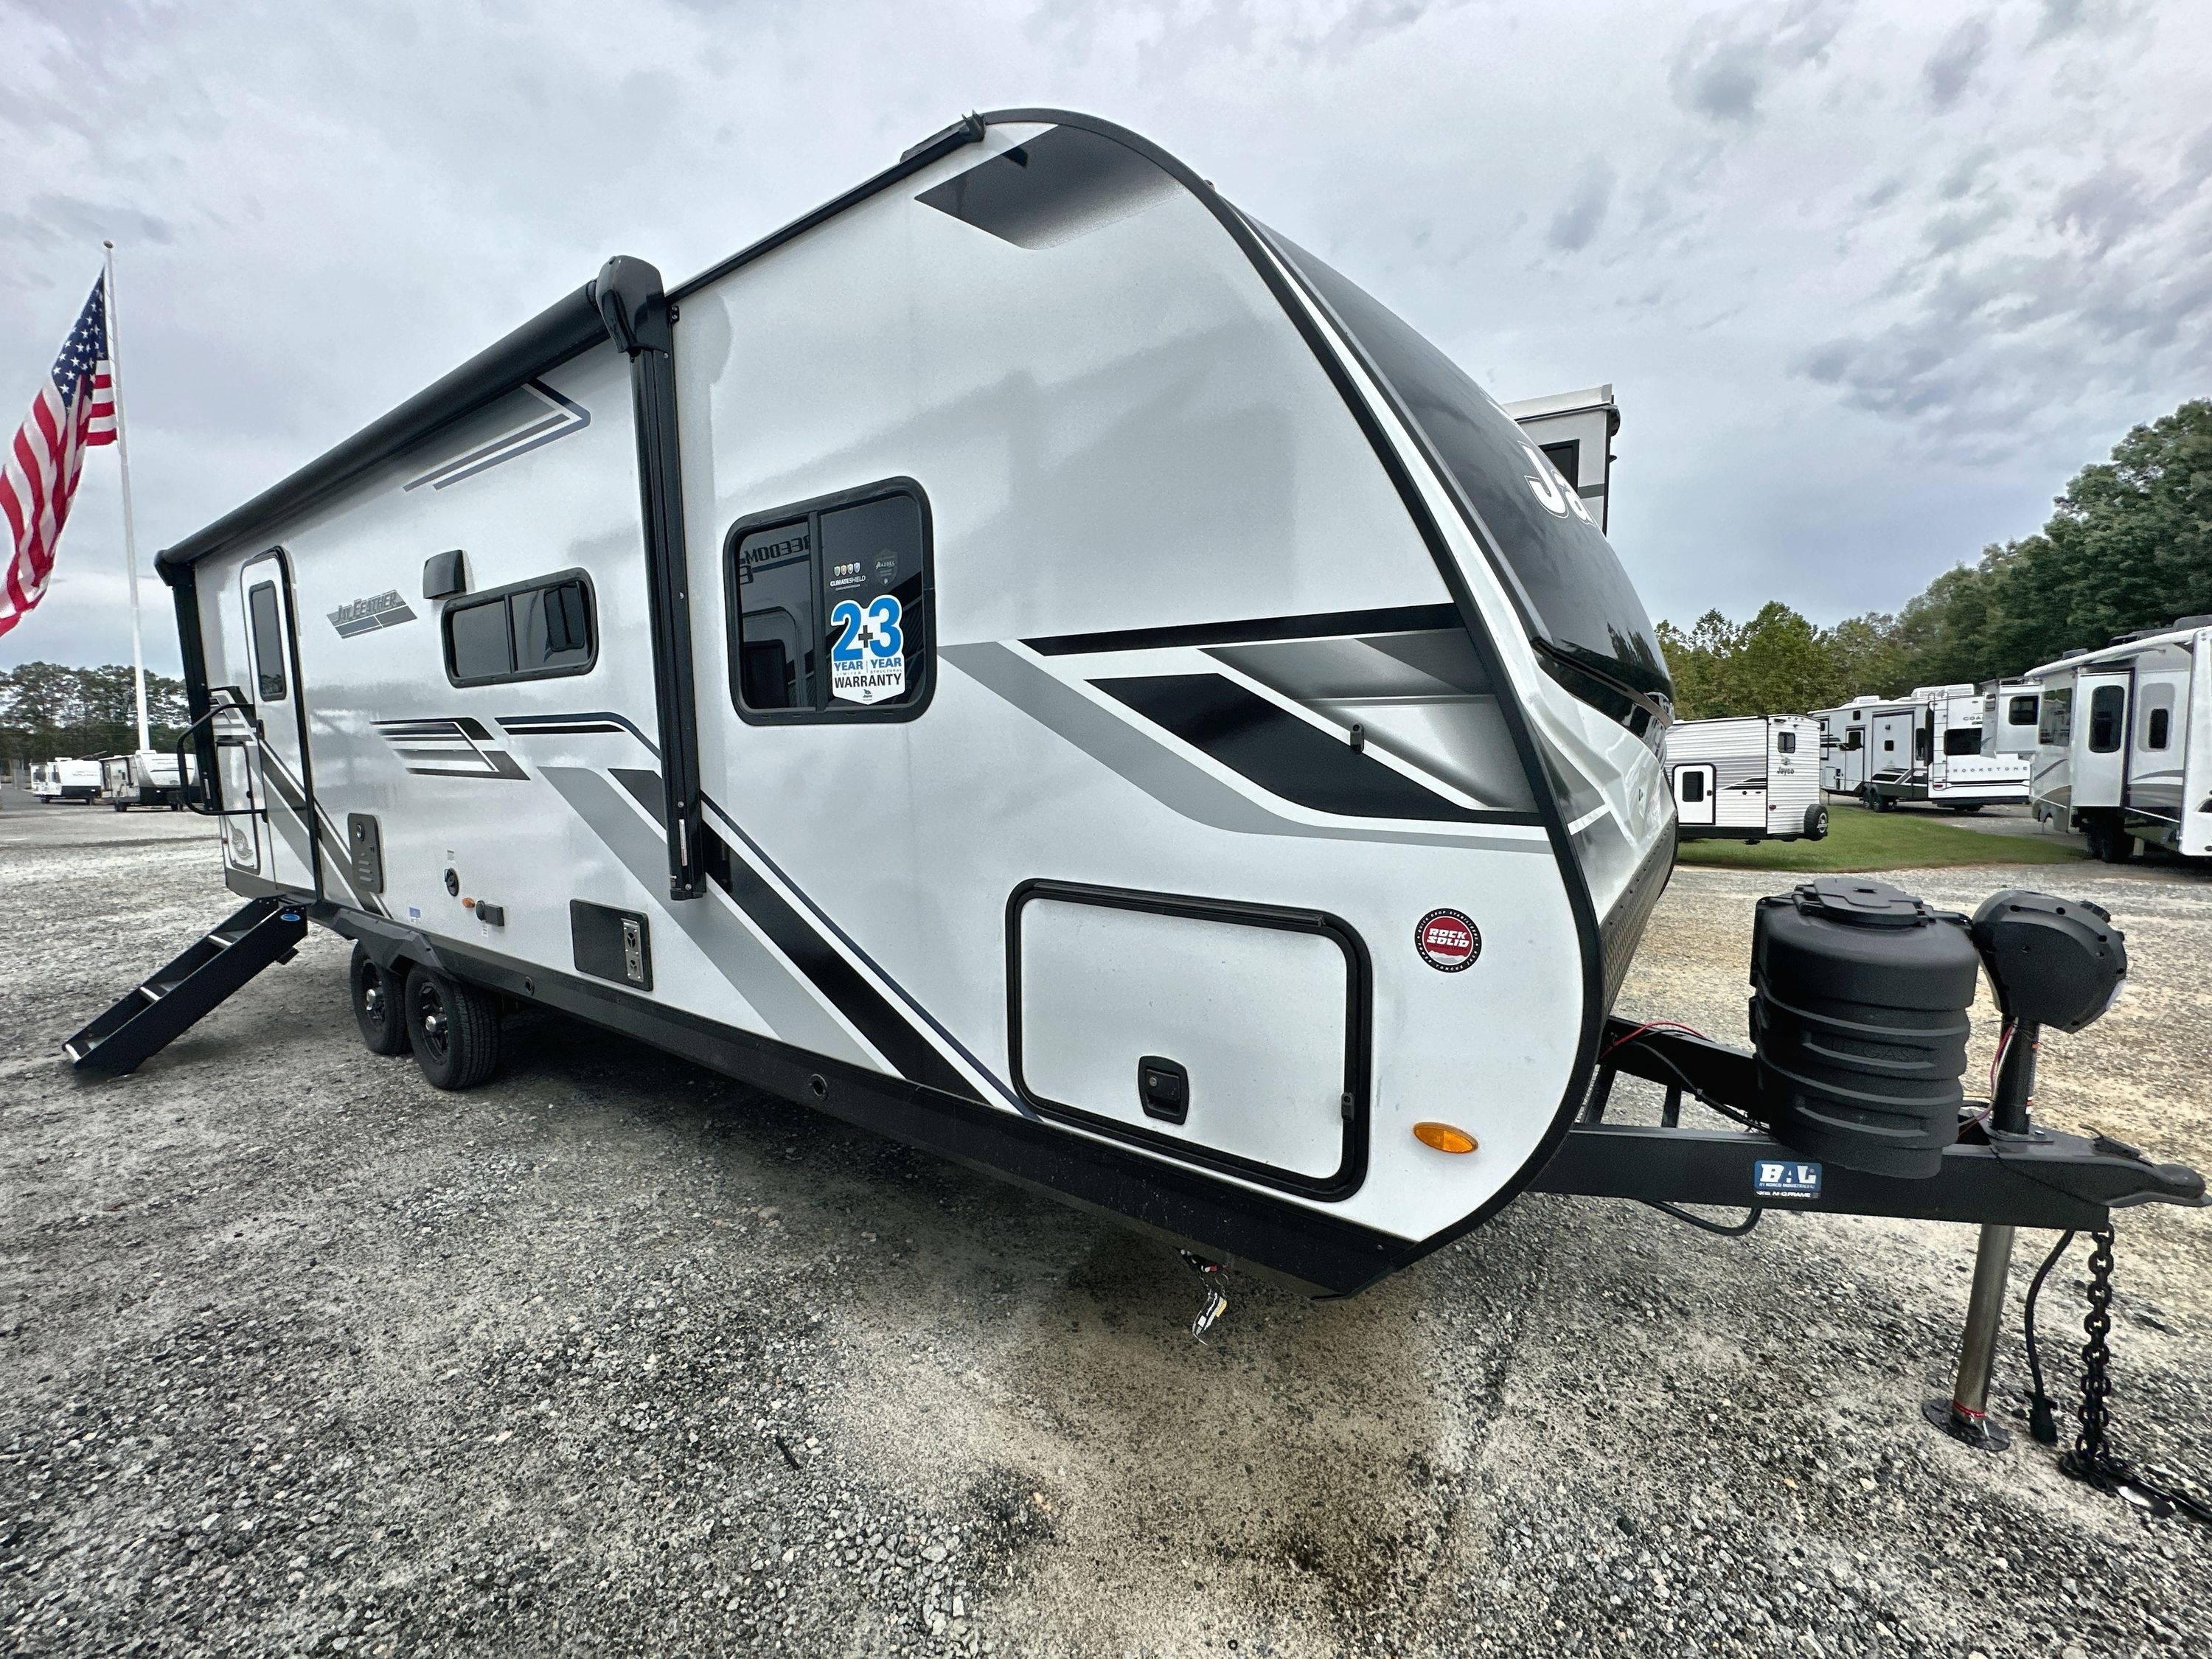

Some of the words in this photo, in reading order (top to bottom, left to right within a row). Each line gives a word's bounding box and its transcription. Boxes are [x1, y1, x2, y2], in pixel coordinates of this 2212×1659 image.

[830, 575, 866, 587] CLIMATESHIELD
[834, 661, 863, 671] YEAR
[870, 658, 902, 668] YEAR
[834, 673, 902, 688] WARRANTY
[1777, 767, 1795, 776] Jayco
[1418, 918, 1429, 933] QUICK
[1429, 928, 1468, 939] ROCK
[1426, 935, 1470, 947] SOLID
[1760, 1164, 1817, 1184] BAL
